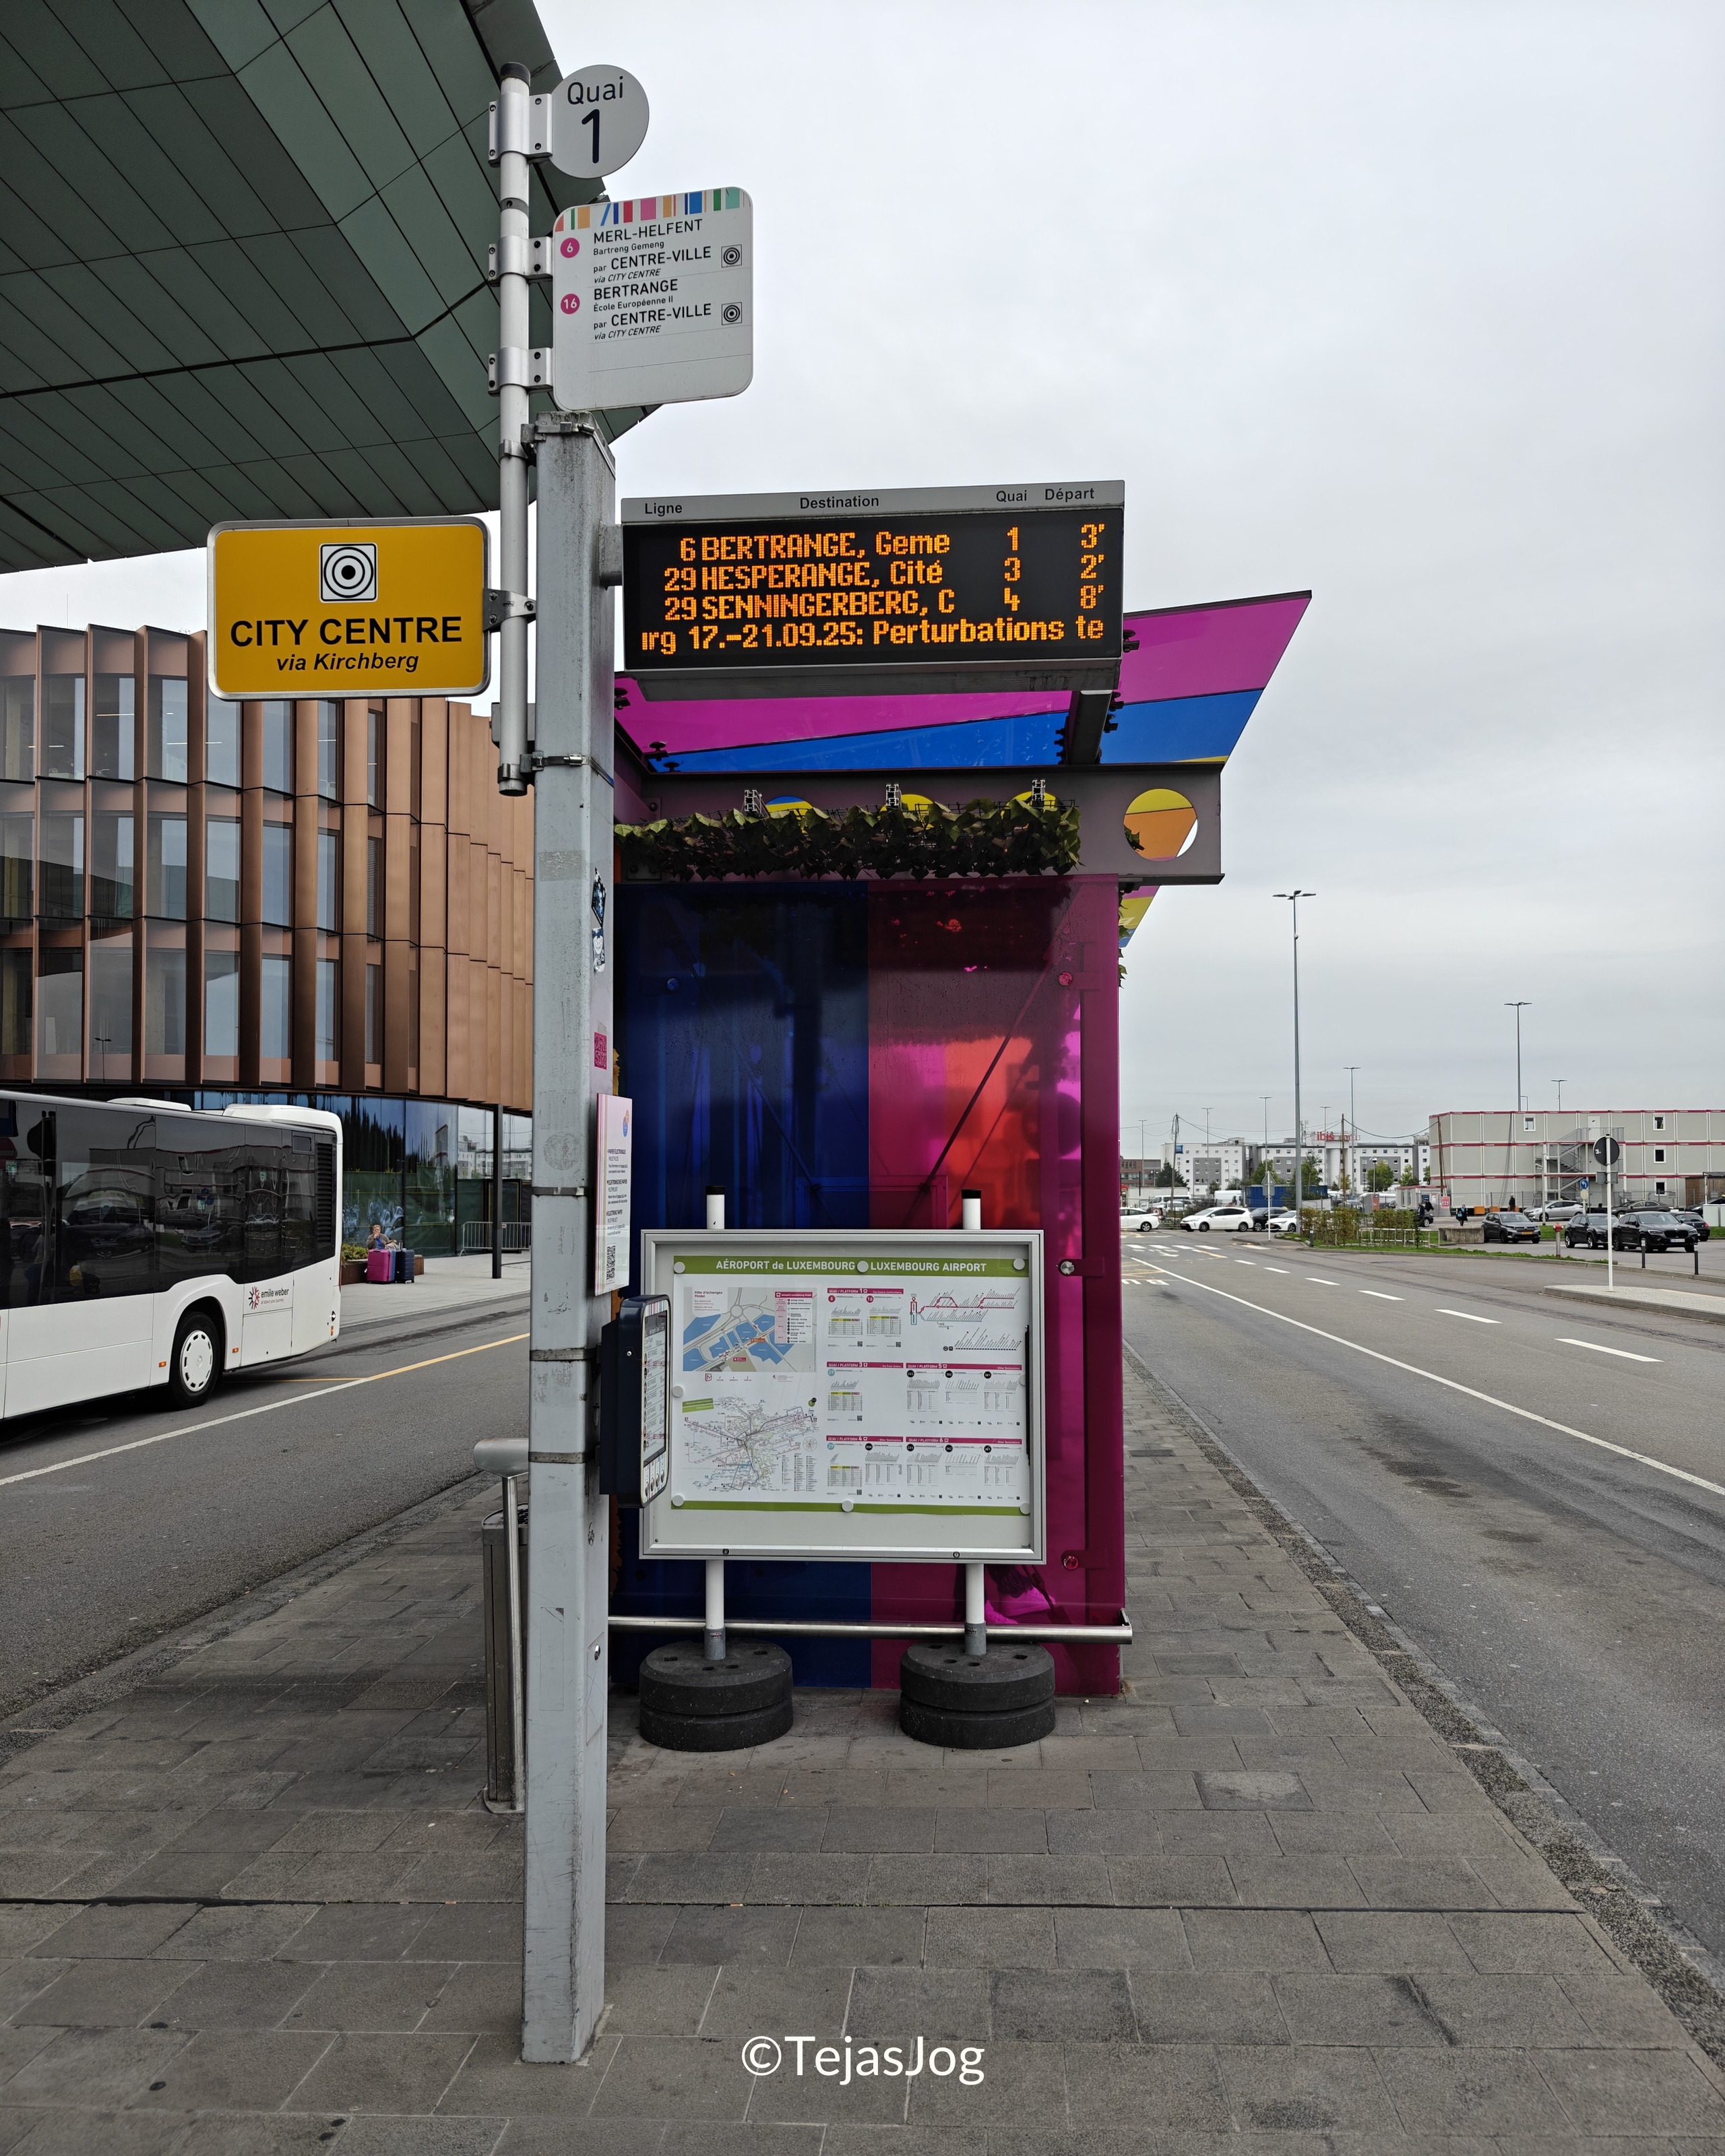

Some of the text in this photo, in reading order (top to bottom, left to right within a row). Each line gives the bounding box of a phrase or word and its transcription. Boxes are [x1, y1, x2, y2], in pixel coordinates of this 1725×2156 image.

[567, 75, 624, 105] Quai
[582, 108, 600, 164] 1
[594, 219, 703, 244] MERL-HELFENT
[567, 242, 573, 253] 6
[594, 241, 664, 255] Bartreng Gemeng
[594, 246, 711, 274] par CENTRE-VILLE
[594, 268, 661, 284] via CITY CENTRE
[594, 279, 678, 300] BERTRANGE
[563, 298, 577, 309] 16
[594, 303, 615, 312] École
[617, 298, 666, 309] Européenne
[594, 303, 711, 330] par CENTRE-VILLE
[608, 329, 627, 338] CITY
[628, 325, 661, 336] CENTRE
[644, 486, 1094, 519] Ligne Destination Quai Départ
[680, 524, 1105, 562] 6 BERTRANGE, Geme 1 3'
[664, 554, 1105, 592] 29 HESPERANGE, Cité 3 2'
[664, 597, 697, 622] 29
[702, 590, 927, 621] SENNINGERBERG,
[938, 589, 955, 614] C
[1004, 588, 1021, 612] 4
[230, 616, 462, 647] CITY CENTRE
[873, 616, 1064, 645] Perturbations
[1075, 618, 1104, 640] te
[277, 652, 419, 673] via Kirchberg
[1316, 1131, 1334, 1141] ibis
[716, 1259, 986, 1272] AÉROPORT de LUXEMBOURG LUXEMBOURG AIRPORT
[261, 1288, 289, 1298] emile weber
